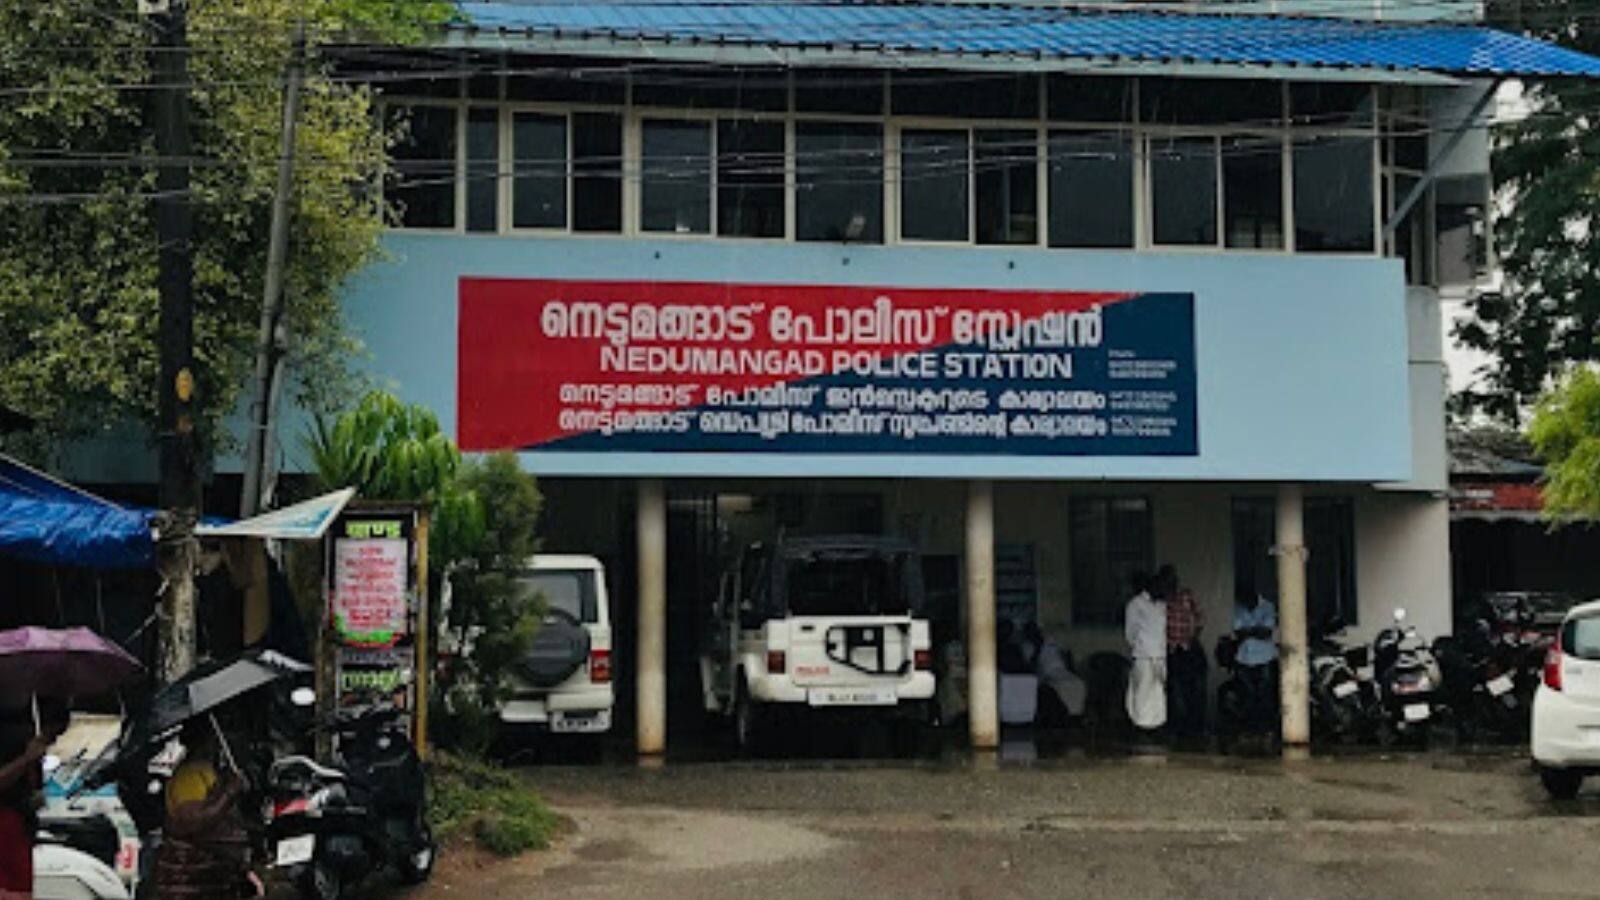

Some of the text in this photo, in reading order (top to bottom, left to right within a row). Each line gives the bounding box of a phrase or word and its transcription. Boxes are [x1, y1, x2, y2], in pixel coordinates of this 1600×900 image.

[541, 300, 764, 346] നെടുമങ്ങാട്
[600, 346, 1073, 379] NEDUMANGAD POLICE STATION
